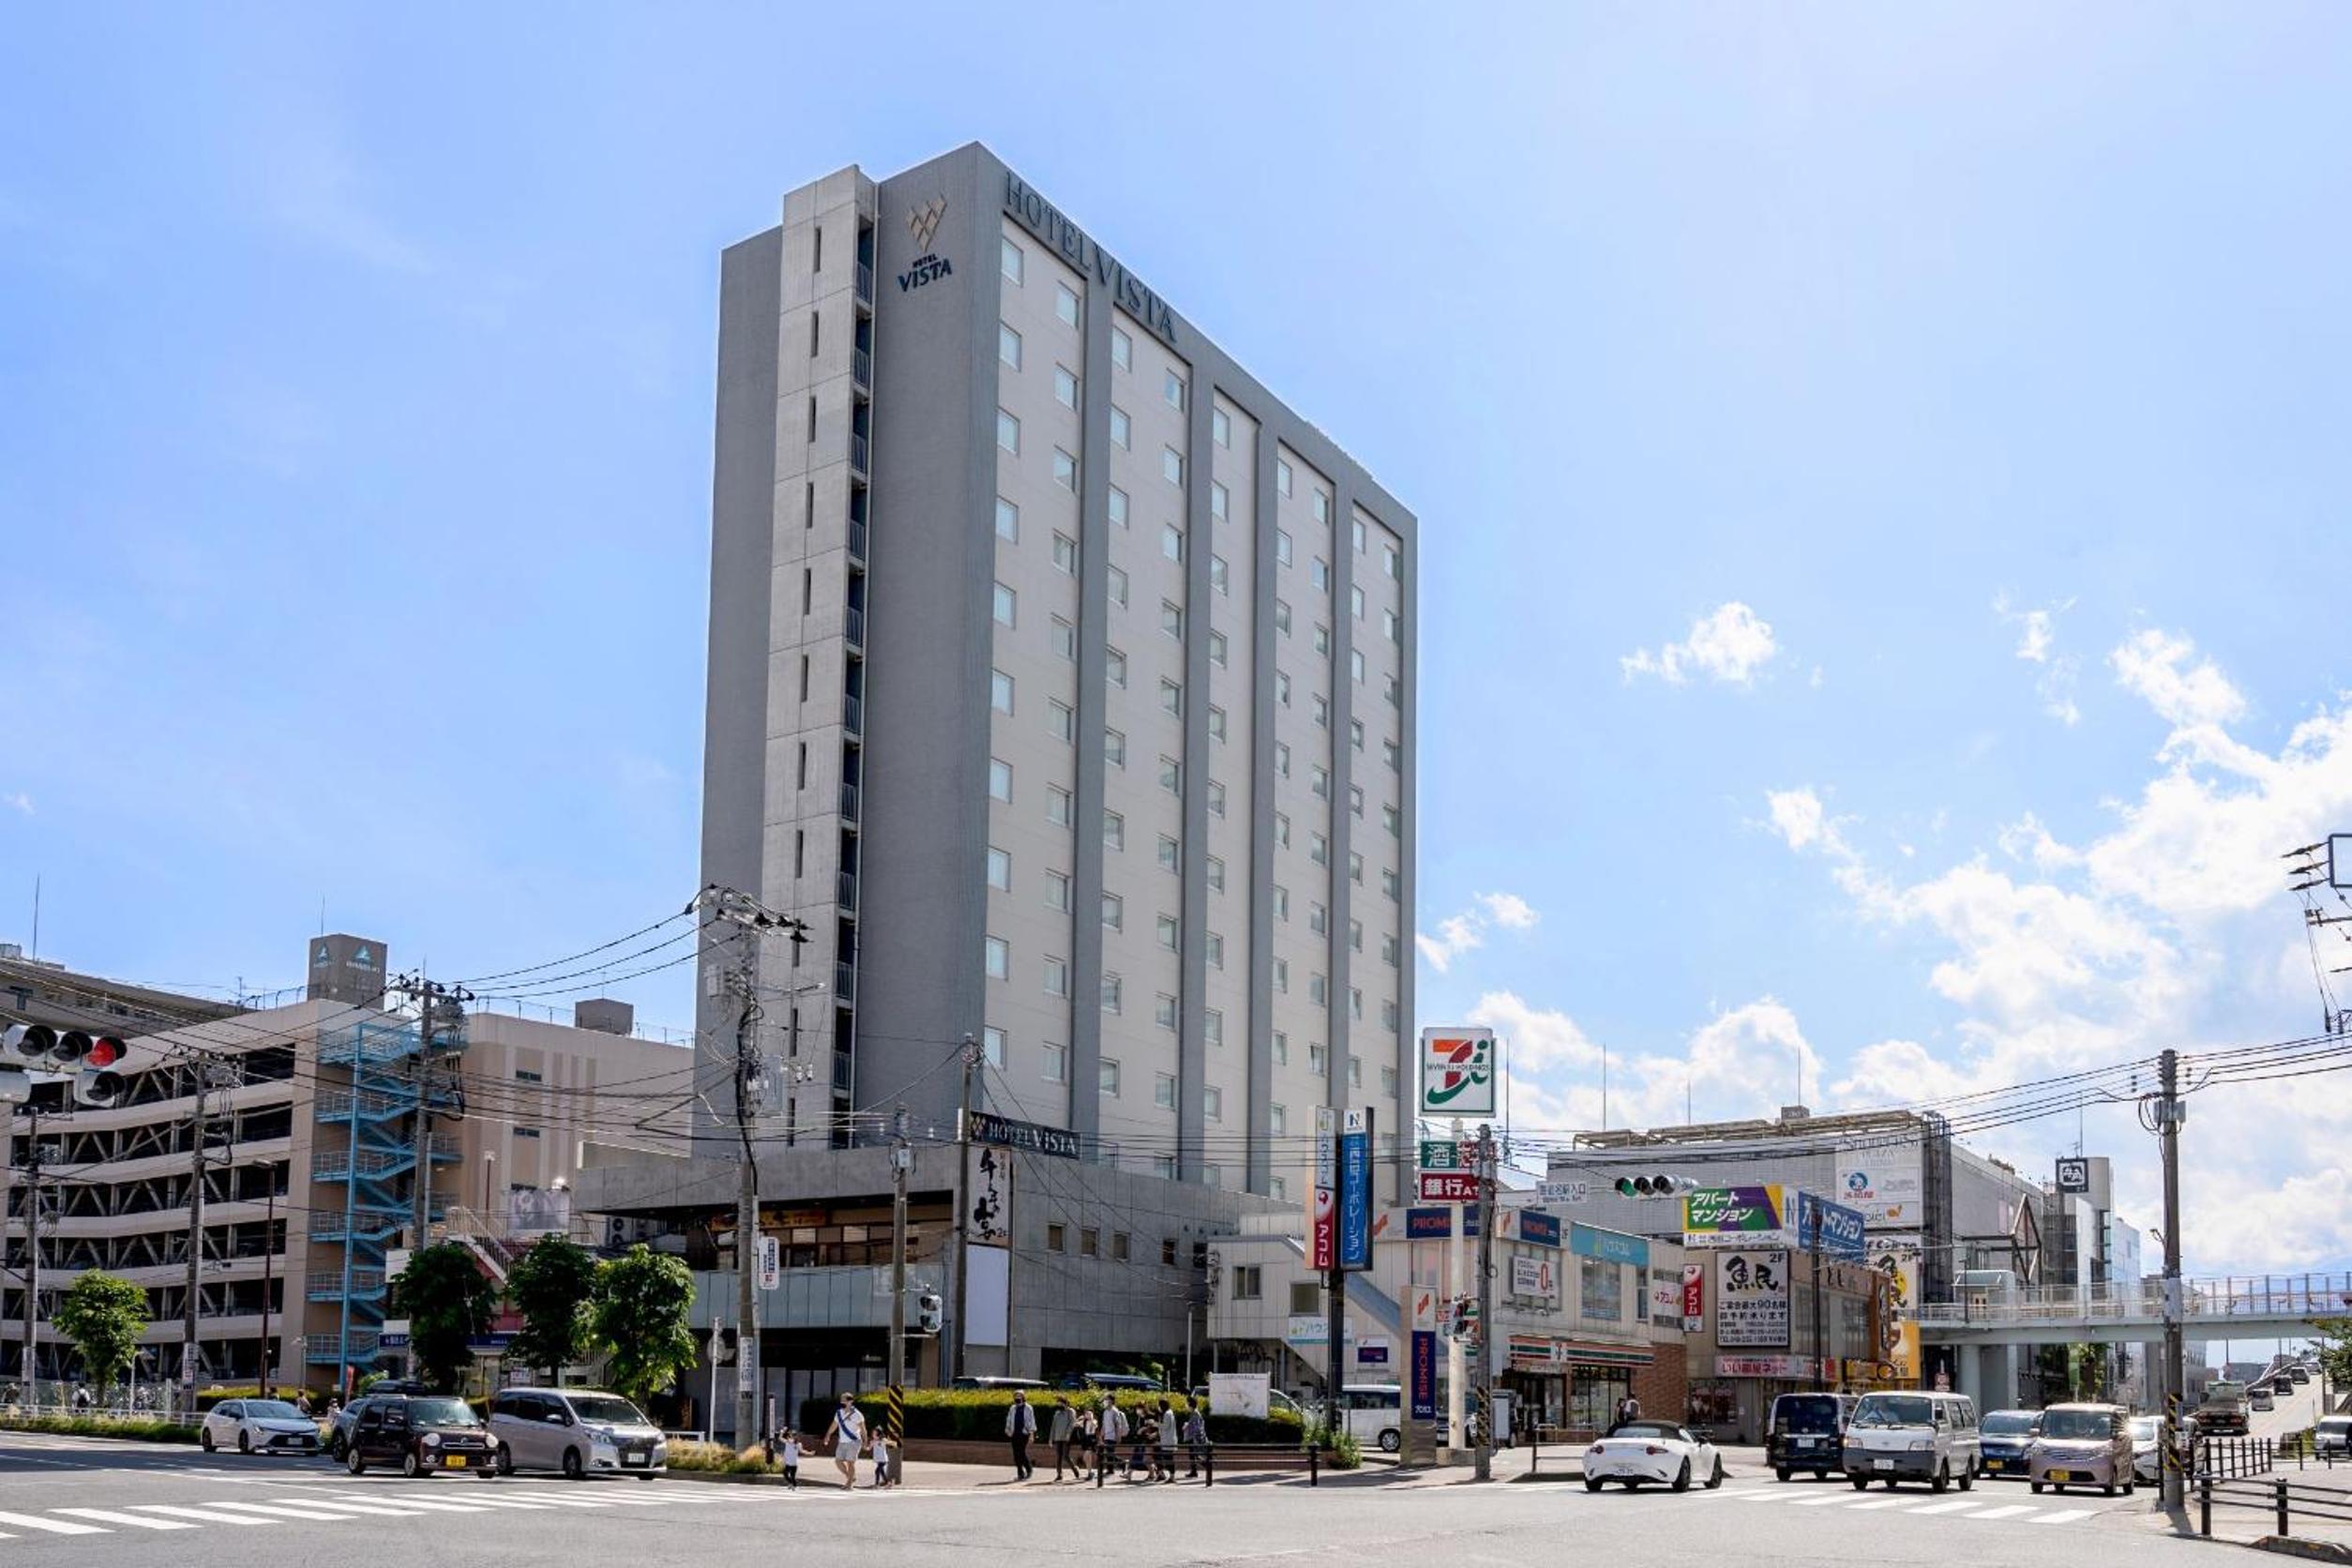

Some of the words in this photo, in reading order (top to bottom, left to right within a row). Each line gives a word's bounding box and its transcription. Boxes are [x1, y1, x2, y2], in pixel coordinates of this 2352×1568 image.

[912, 253, 938, 268] HOTEL
[1006, 172, 1093, 271] HOTEL
[1095, 244, 1178, 343] VISTA
[897, 259, 952, 292] VISTA
[988, 1122, 1032, 1147] HOTEL
[1033, 1129, 1077, 1154] VISTA
[1427, 1144, 1450, 1167] 酒
[1425, 1178, 1480, 1197] 銀行AT
[1691, 1192, 1739, 1207] アパート
[1692, 1209, 1754, 1223] マンション
[1319, 1224, 1329, 1266] アコム
[1769, 1253, 1785, 1263] 2F
[1726, 1255, 1779, 1292] 魚民
[1688, 1287, 1698, 1315] アコム
[1418, 1336, 1428, 1401] PROMISE
[1722, 1363, 1787, 1374] いい部屋ネット
